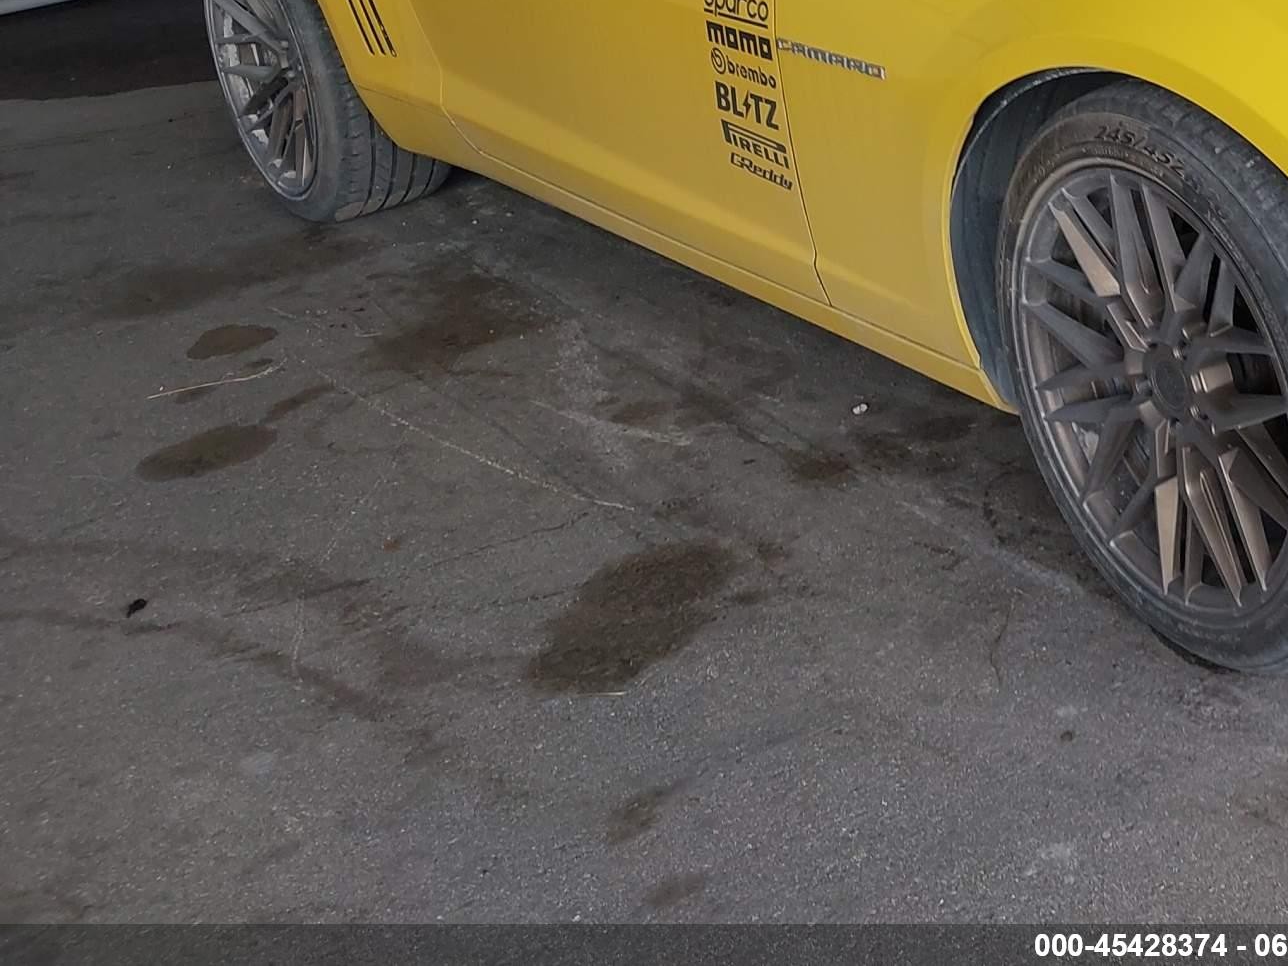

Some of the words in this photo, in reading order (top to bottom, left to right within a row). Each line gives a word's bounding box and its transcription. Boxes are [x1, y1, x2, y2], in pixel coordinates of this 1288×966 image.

[726, 54, 777, 89] brembo
[776, 36, 887, 80] CAMARO
[721, 119, 791, 170] PIRELLI
